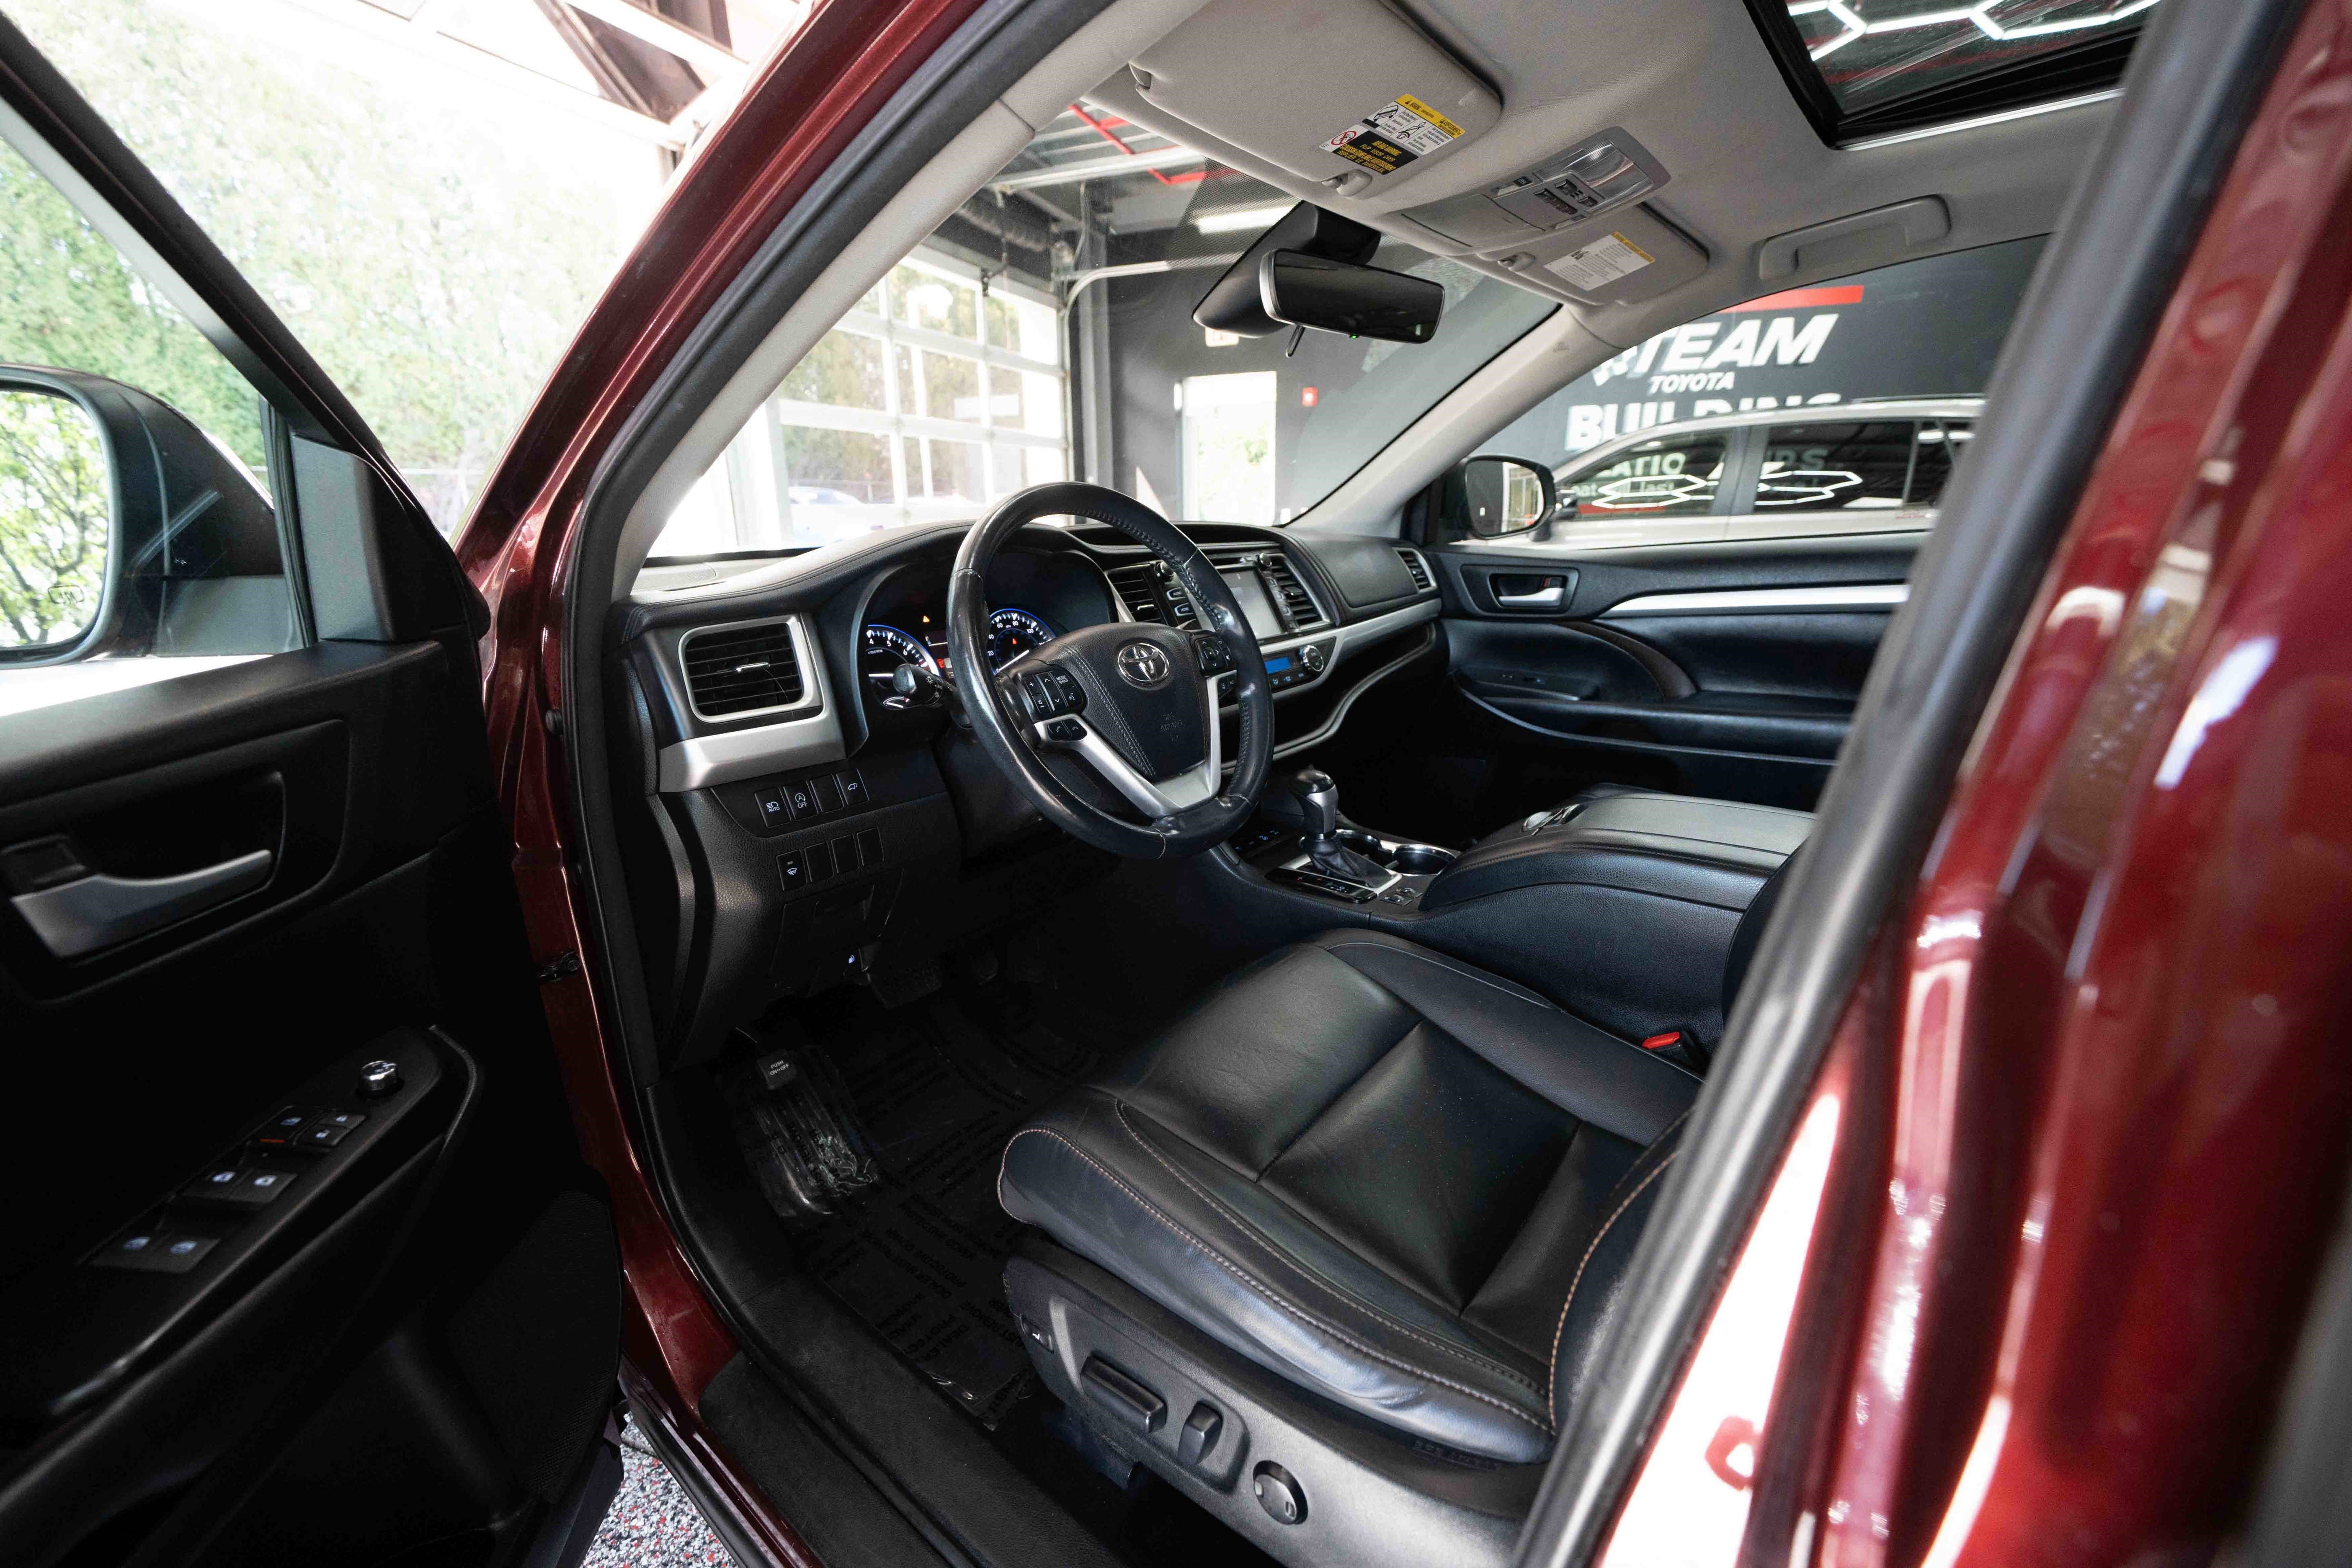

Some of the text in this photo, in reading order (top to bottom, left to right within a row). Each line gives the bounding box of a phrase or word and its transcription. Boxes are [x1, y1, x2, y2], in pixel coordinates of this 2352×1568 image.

[1628, 313, 1840, 376] TEAM
[1648, 372, 1735, 395] TOYOTA
[771, 1059, 784, 1069] PUSH
